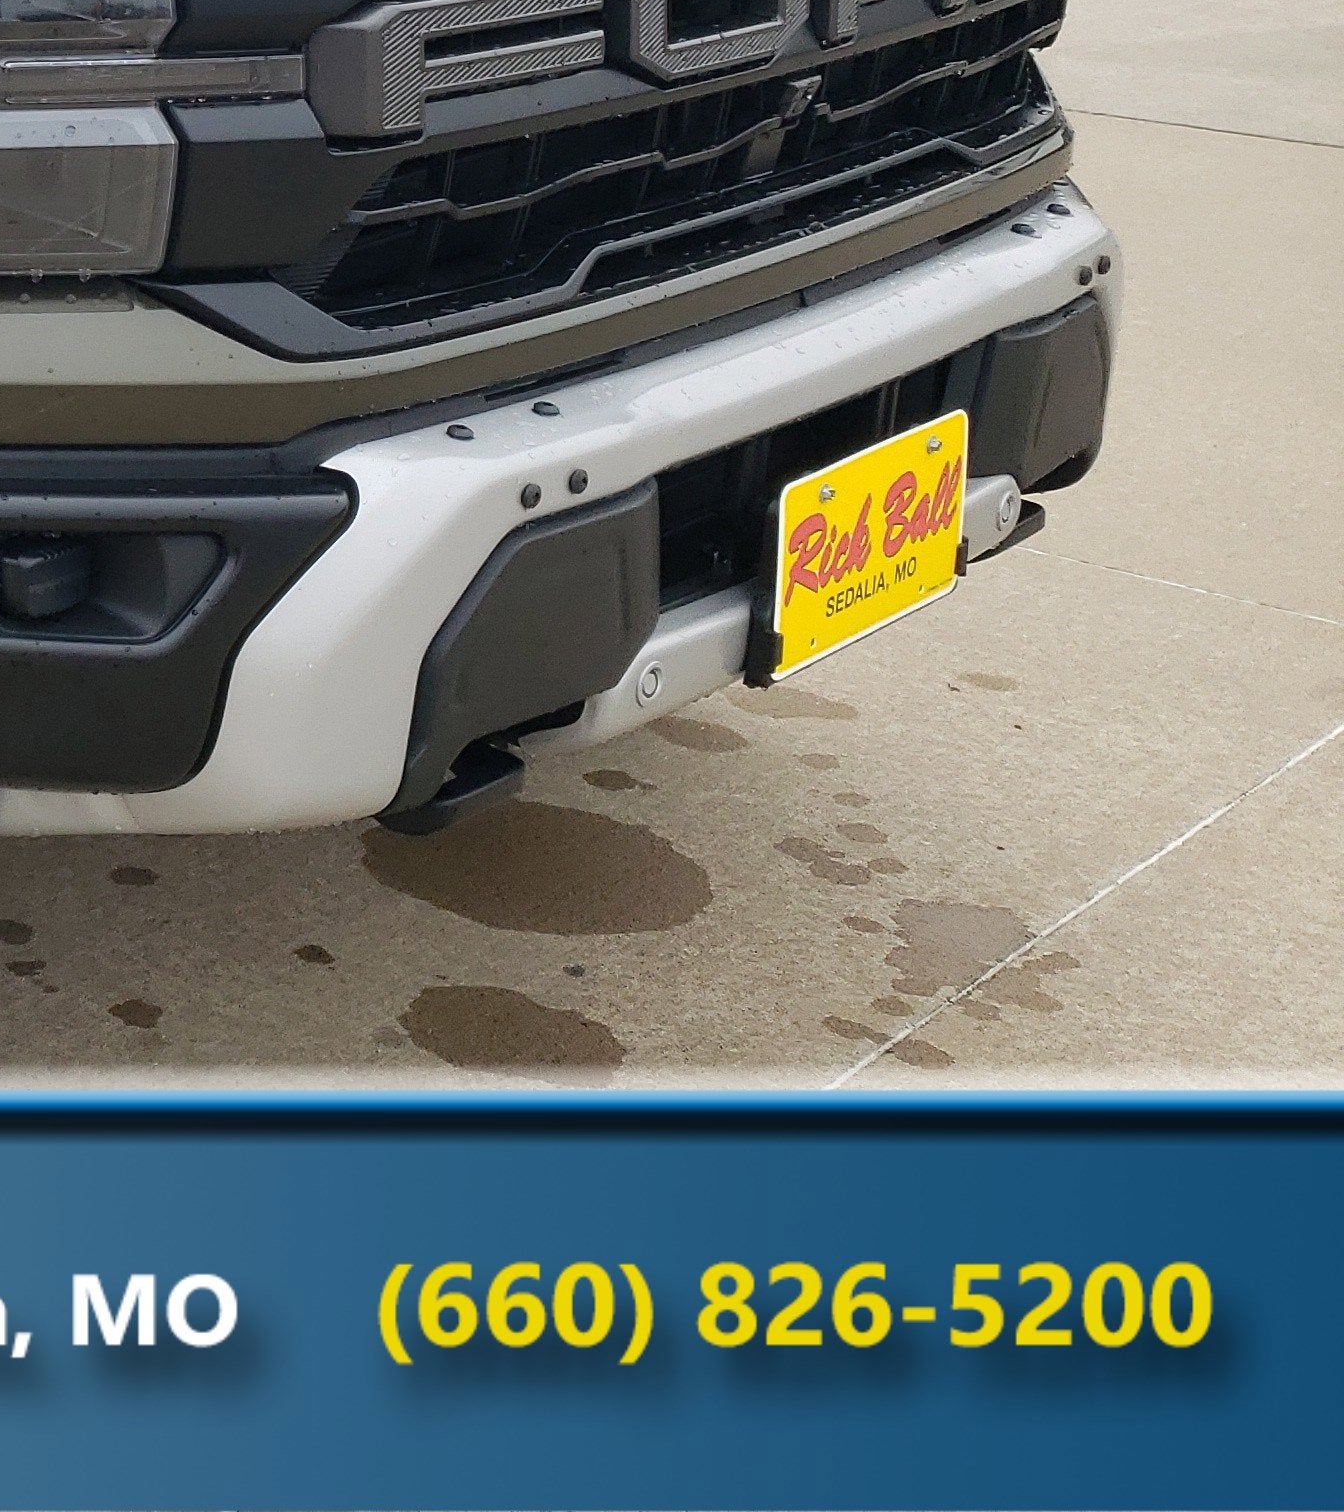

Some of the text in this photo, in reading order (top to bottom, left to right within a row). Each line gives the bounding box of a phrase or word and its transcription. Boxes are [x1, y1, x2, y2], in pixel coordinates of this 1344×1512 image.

[784, 454, 963, 608] Rick Ball
[825, 570, 890, 618] SEDALIA,
[894, 556, 917, 586] MO
